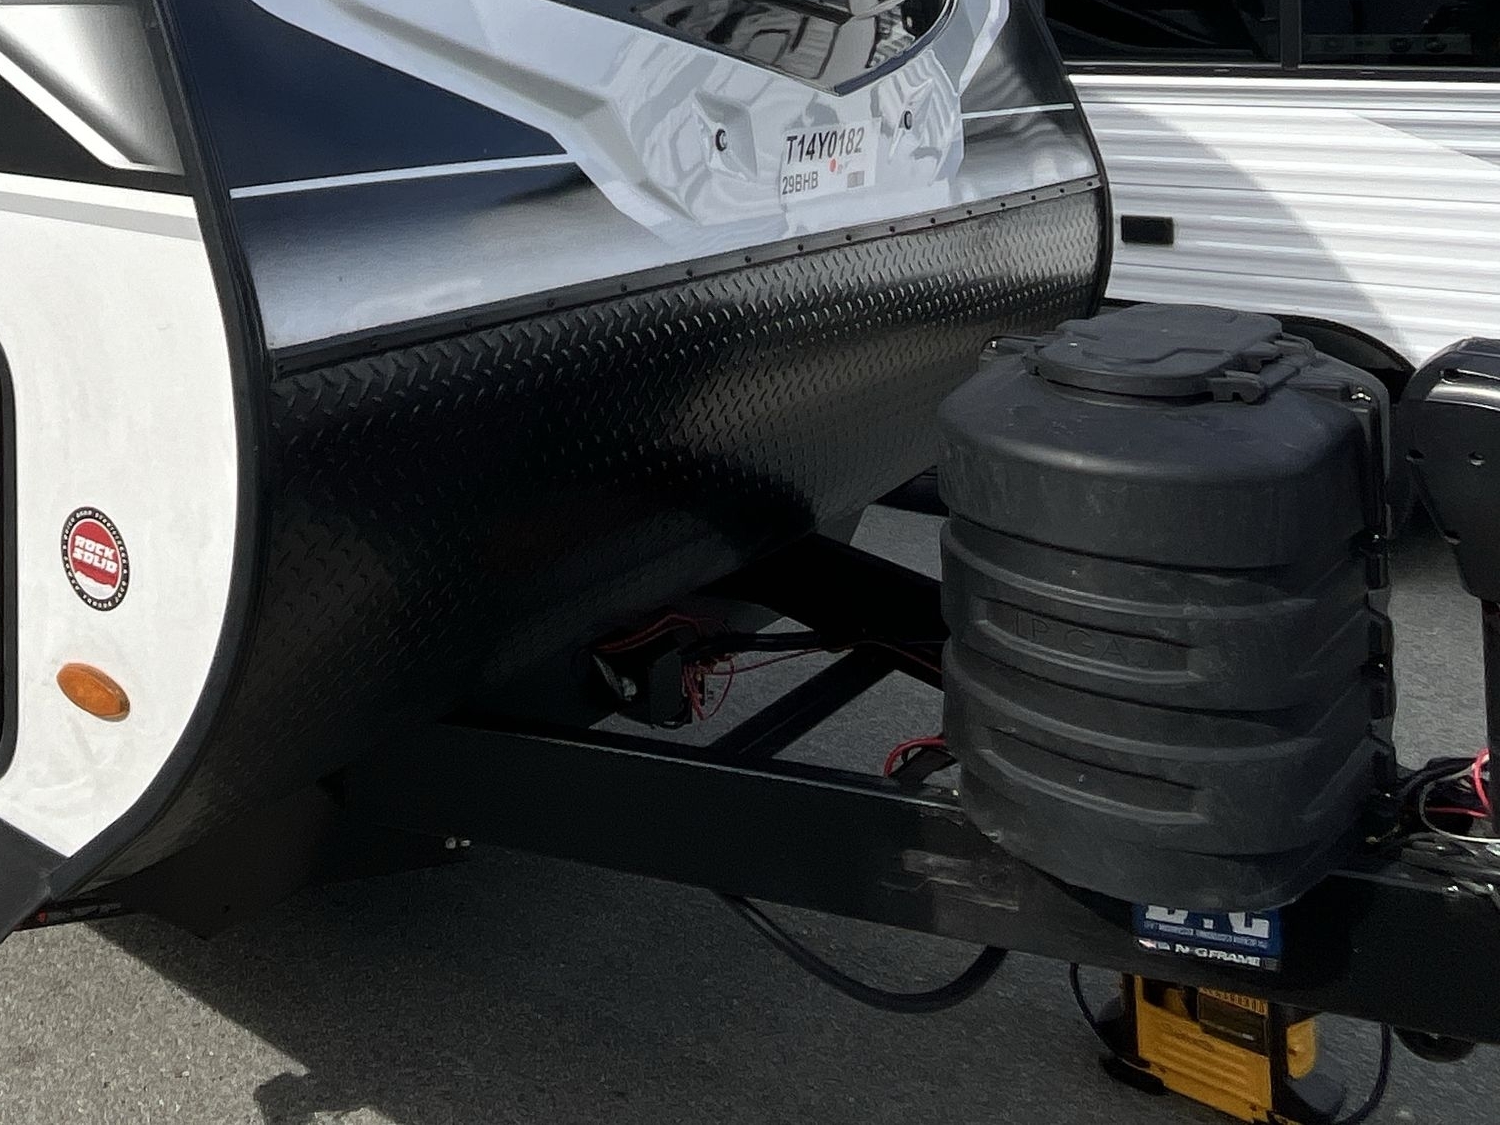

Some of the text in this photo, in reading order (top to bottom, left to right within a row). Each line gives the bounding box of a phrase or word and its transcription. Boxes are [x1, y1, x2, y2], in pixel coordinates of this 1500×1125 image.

[786, 127, 865, 165] T14Y0182
[782, 171, 819, 196] 29BHB
[72, 546, 118, 574] SOLID
[74, 535, 116, 560] ROCK
